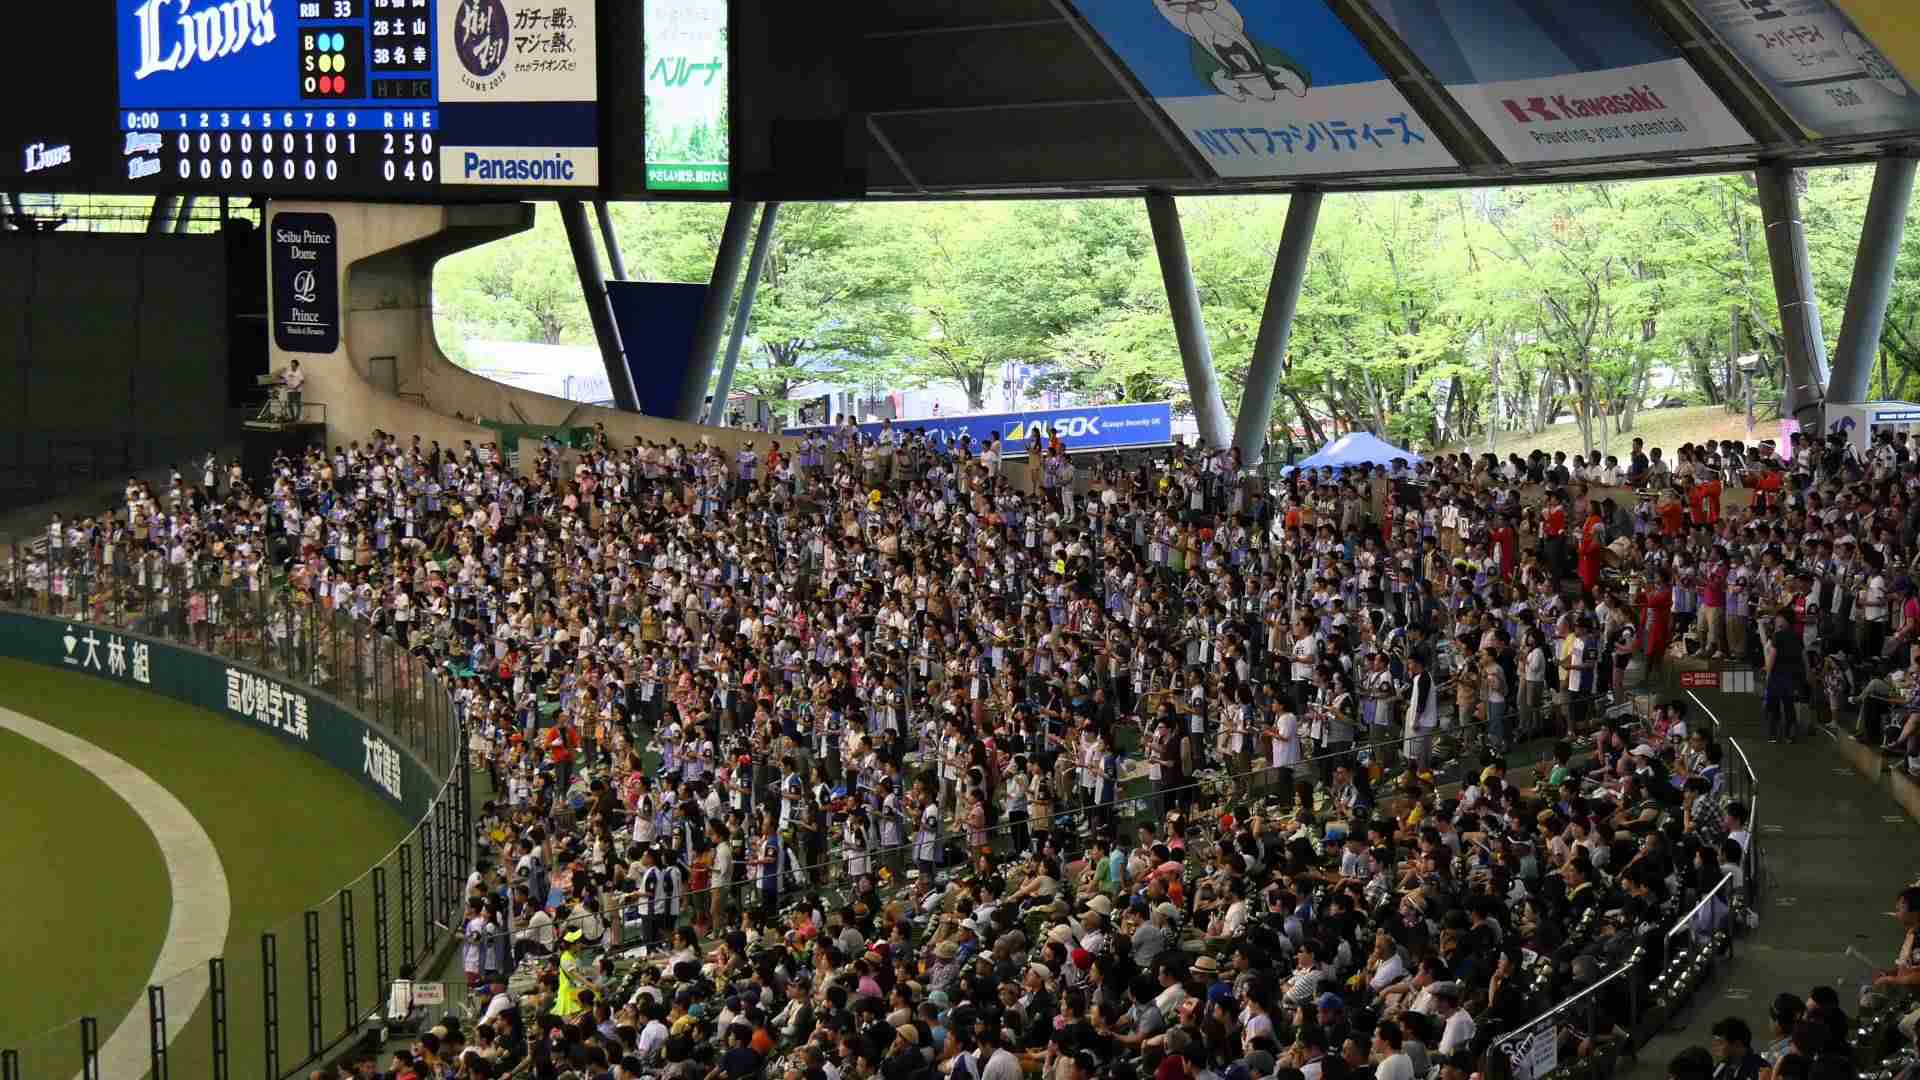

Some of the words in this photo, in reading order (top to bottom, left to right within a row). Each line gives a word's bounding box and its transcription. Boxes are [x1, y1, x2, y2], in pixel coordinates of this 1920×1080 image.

[300, 3, 320, 17] RBI
[334, 1, 352, 18] 33
[373, 21, 389, 35] 2B
[134, 0, 277, 80] Lions
[304, 35, 314, 50] B
[305, 55, 315, 71] S
[373, 48, 390, 64] 3B
[650, 56, 722, 87] ベルーナ
[304, 77, 316, 93] O
[1550, 84, 1668, 119] Kawasaki
[127, 112, 159, 129] 0:00
[179, 112, 187, 128] 1
[200, 112, 208, 128] 2
[220, 112, 230, 128] 3
[241, 112, 250, 128] 4
[263, 112, 272, 128] 5
[284, 112, 293, 128] 6
[304, 112, 313, 128] 7
[326, 112, 335, 128] 8
[347, 112, 356, 128] 9
[383, 112, 394, 128] R
[403, 112, 414, 128] H
[422, 112, 431, 128] E
[179, 133, 190, 153] 0
[200, 133, 210, 153] 0
[220, 133, 231, 153] 0
[241, 133, 252, 153] 0
[262, 133, 272, 153] 0
[284, 133, 294, 153] 0
[304, 133, 313, 154] 1
[326, 133, 336, 154] 0
[348, 133, 356, 154] 1
[384, 133, 394, 154] 2
[404, 133, 414, 154] 5
[422, 133, 432, 154] 0
[1193, 111, 1426, 157] NTTファシリティーズ
[180, 158, 190, 178] 0
[201, 158, 211, 178] 0
[221, 158, 232, 178] 0
[242, 158, 252, 178] 0
[263, 160, 273, 180] 0
[284, 160, 295, 180] 0
[305, 160, 316, 180] 0
[326, 160, 337, 180] 0
[384, 160, 394, 180] 0
[404, 160, 415, 180] 4
[422, 160, 432, 180] 0
[464, 152, 575, 180] Panasonic
[276, 229, 301, 243] Seibu
[303, 230, 331, 244] Prince
[291, 246, 317, 260] Dome
[292, 308, 320, 322] Prince
[1024, 416, 1100, 441] ALSOK
[81, 629, 151, 684] 大林組
[226, 666, 309, 741] 高砂熱学工業
